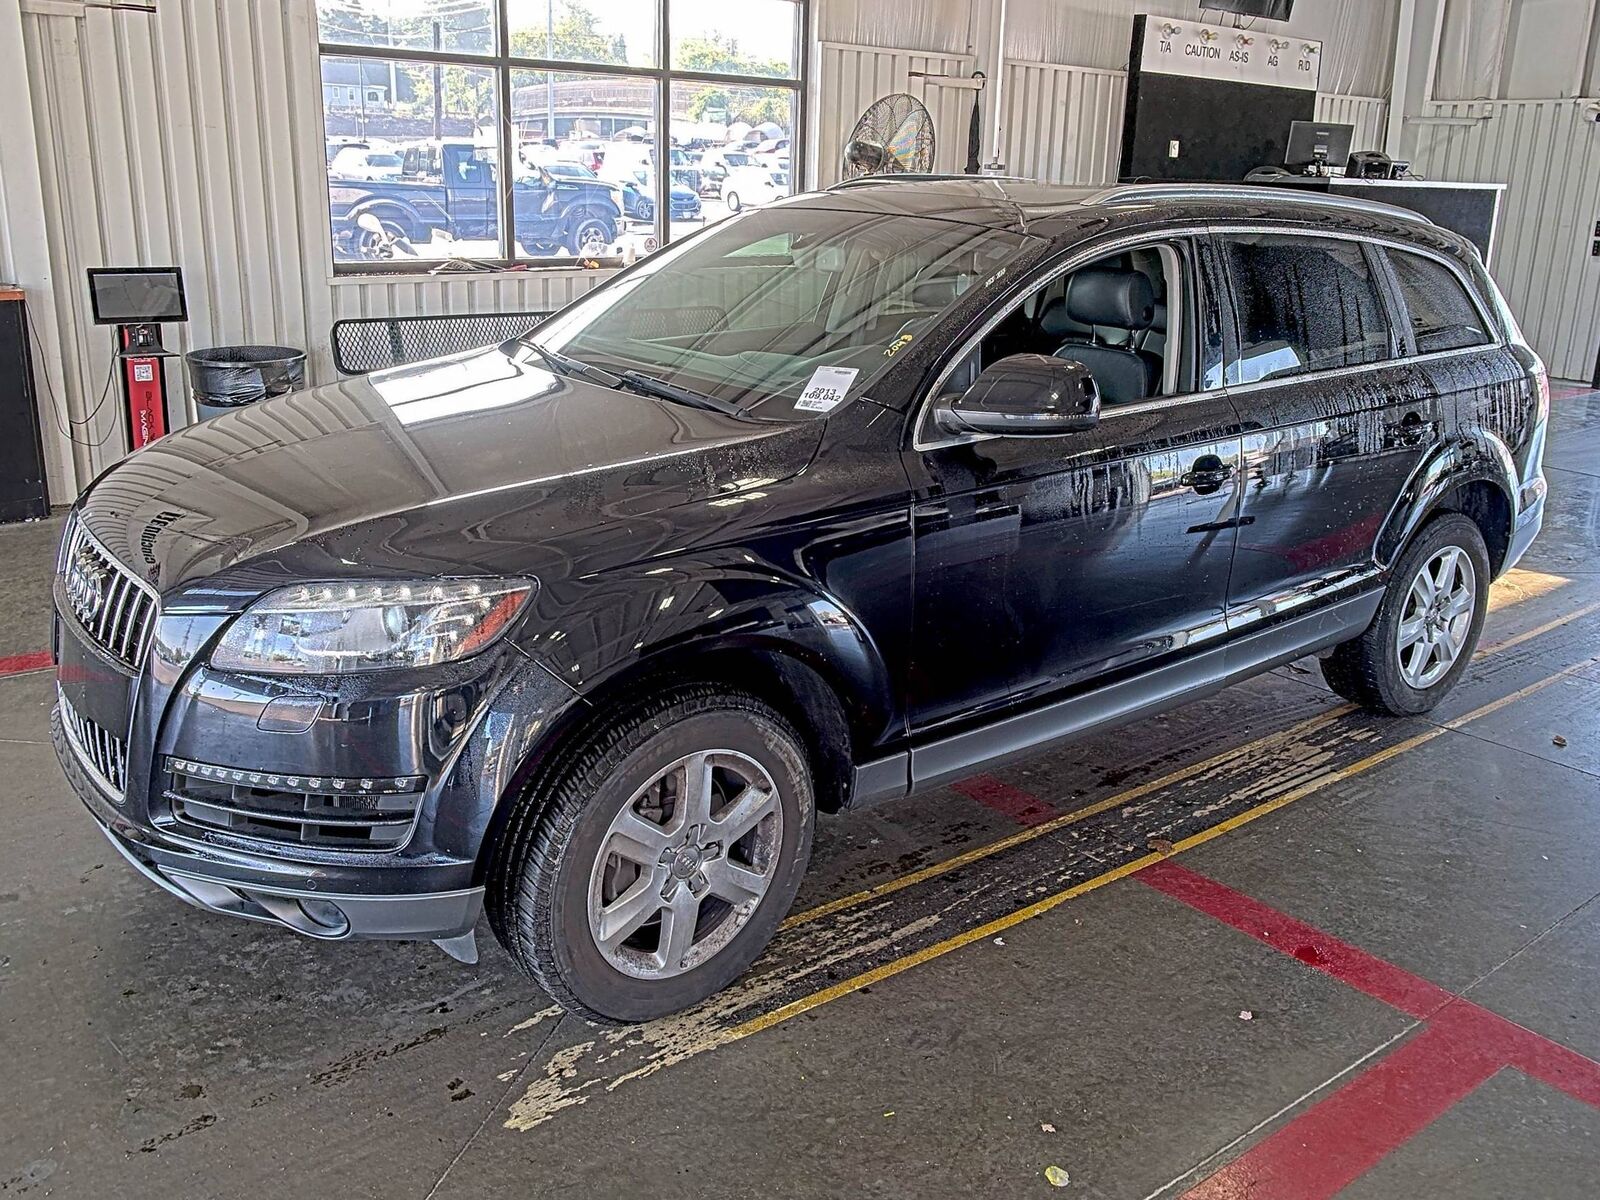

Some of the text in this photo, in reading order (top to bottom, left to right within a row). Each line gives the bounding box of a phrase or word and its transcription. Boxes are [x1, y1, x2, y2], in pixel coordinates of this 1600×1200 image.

[1159, 40, 1172, 53] T/A
[1185, 43, 1221, 59] CAUTION
[1229, 51, 1249, 64] AS-IS
[1267, 55, 1279, 67] AG
[813, 387, 837, 395] 2013
